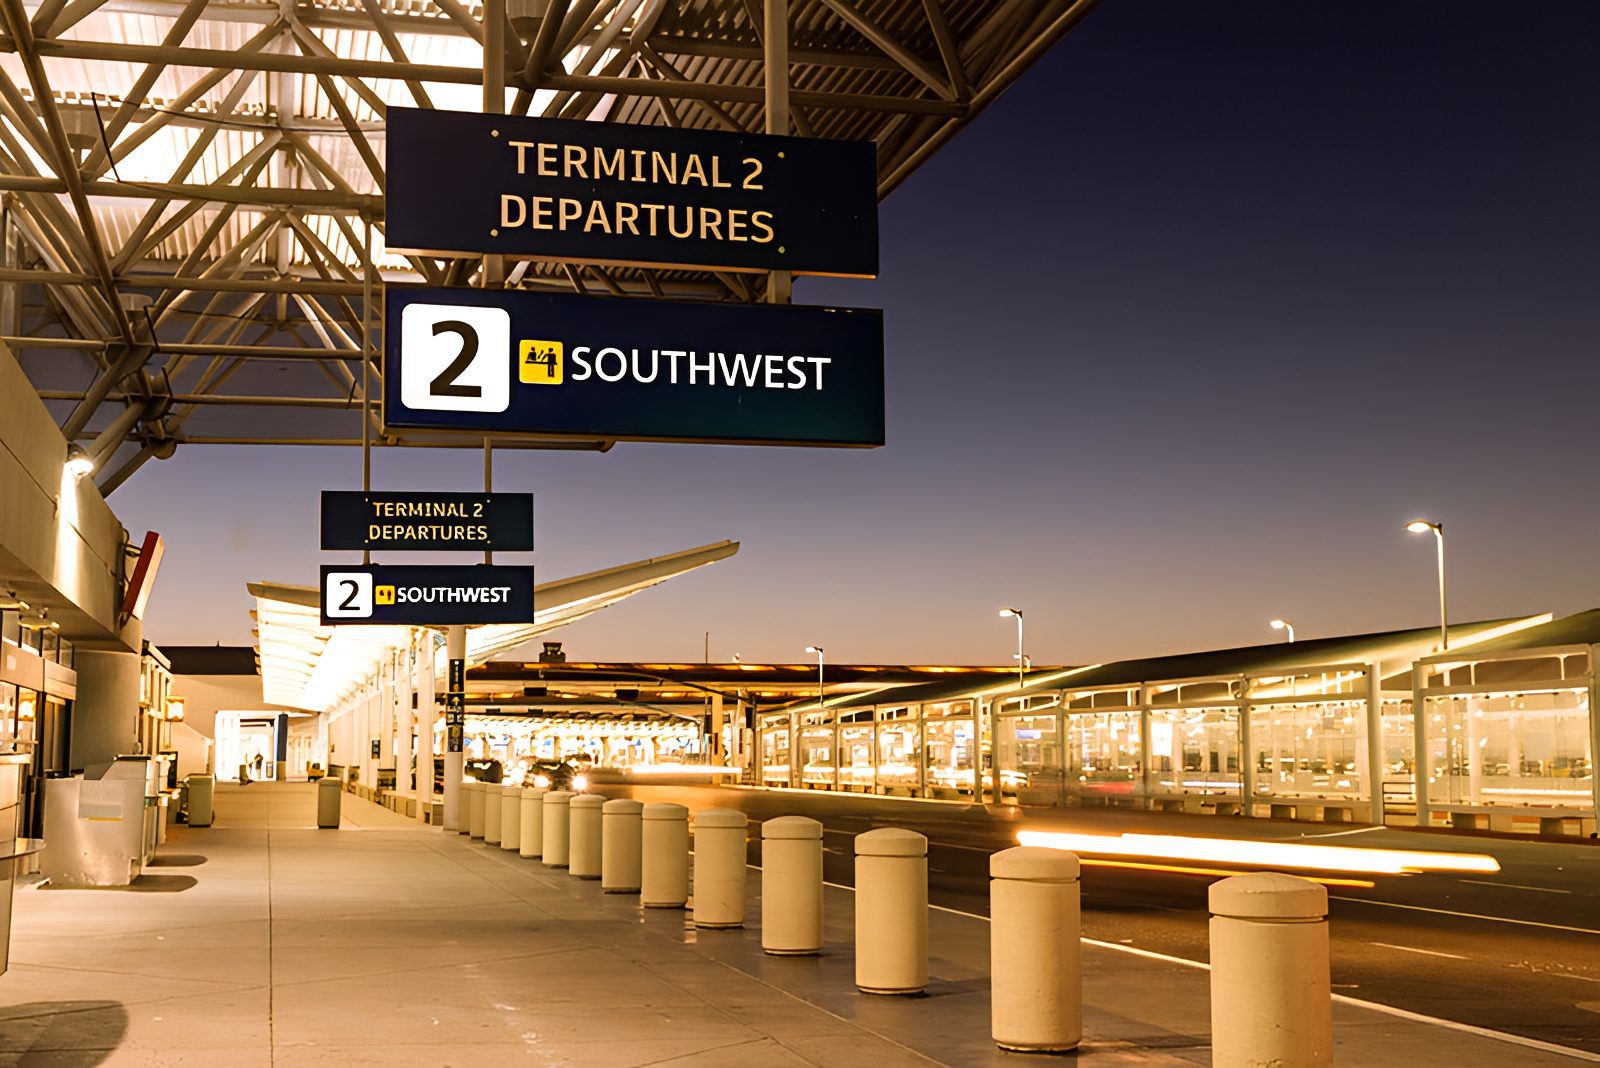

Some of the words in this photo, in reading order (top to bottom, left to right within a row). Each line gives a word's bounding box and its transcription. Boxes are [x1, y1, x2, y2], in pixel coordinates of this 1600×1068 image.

[508, 141, 732, 189] TERMINAL
[742, 158, 764, 191] 2
[500, 194, 775, 244] DEPARTURES
[429, 320, 483, 398] 2
[571, 346, 832, 391] SOUTHWEST
[372, 502, 469, 517] TERMINAL
[473, 503, 483, 518] 2
[369, 525, 488, 540] DEPARTURES
[338, 579, 361, 611] 2
[397, 587, 511, 603] SOUTHWEST
